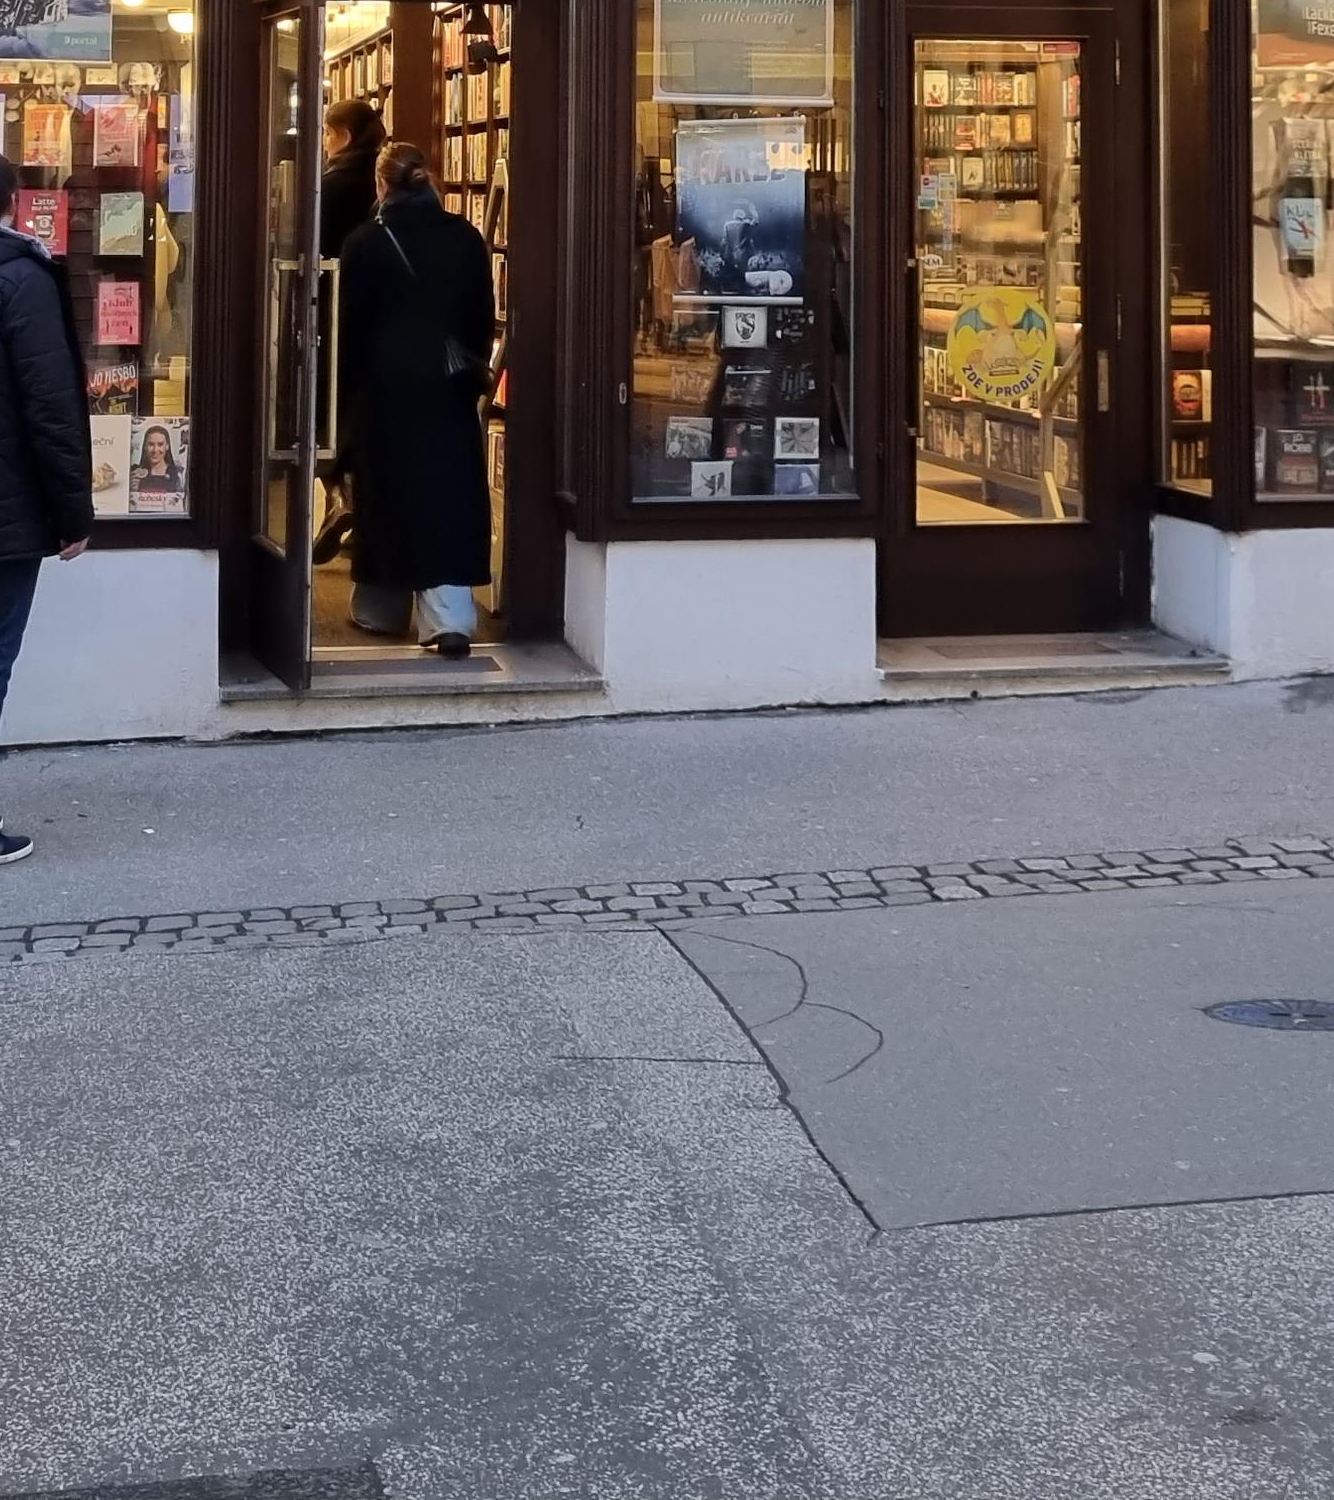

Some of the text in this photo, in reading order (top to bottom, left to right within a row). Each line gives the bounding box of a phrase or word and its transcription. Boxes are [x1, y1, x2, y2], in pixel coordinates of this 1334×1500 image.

[961, 359, 1047, 397] ZDE V PRODEJI!
